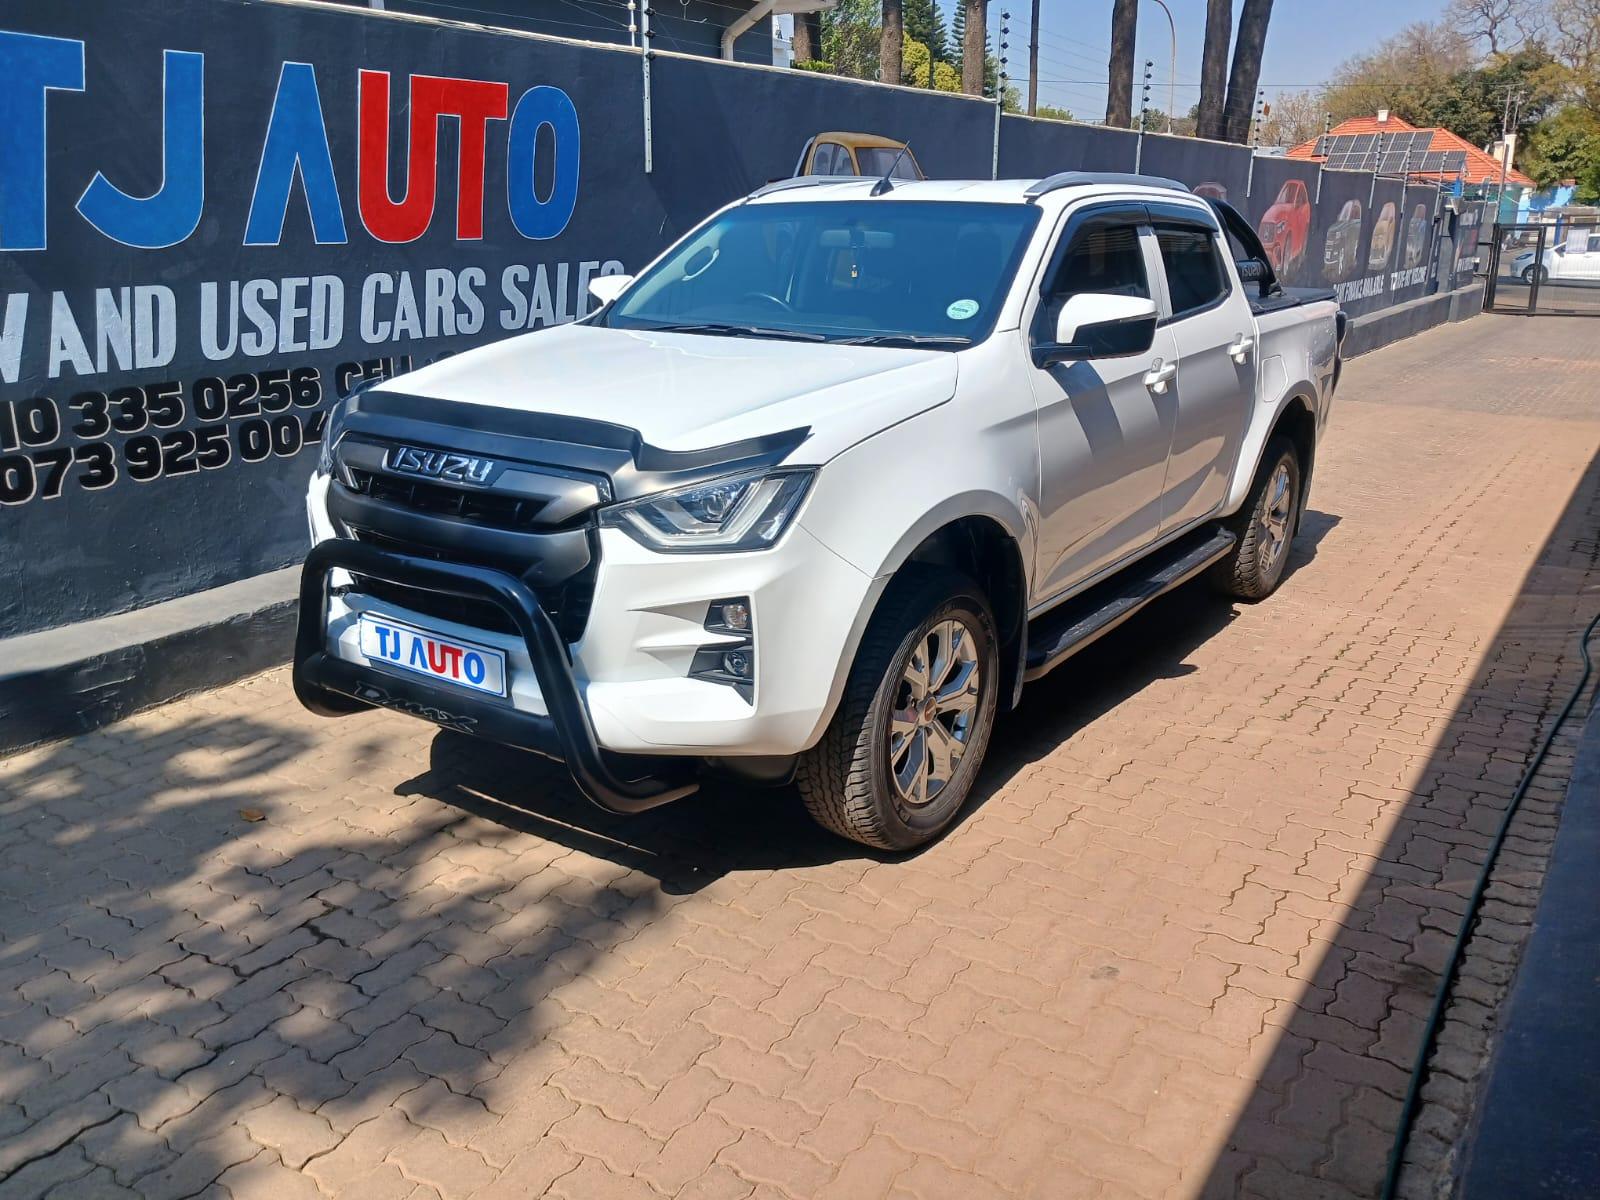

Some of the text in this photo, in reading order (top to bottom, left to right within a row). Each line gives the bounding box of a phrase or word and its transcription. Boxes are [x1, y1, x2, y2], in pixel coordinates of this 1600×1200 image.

[0, 30, 580, 249] TJ AUTO
[48, 285, 177, 378] AND
[200, 275, 345, 361] USED
[361, 266, 485, 343] CARS
[68, 381, 184, 440] 335
[192, 367, 322, 423] 0256
[0, 441, 118, 506] 073
[124, 424, 232, 483] 925
[392, 447, 494, 482] ISUZU
[375, 626, 486, 685] TJ AUTO
